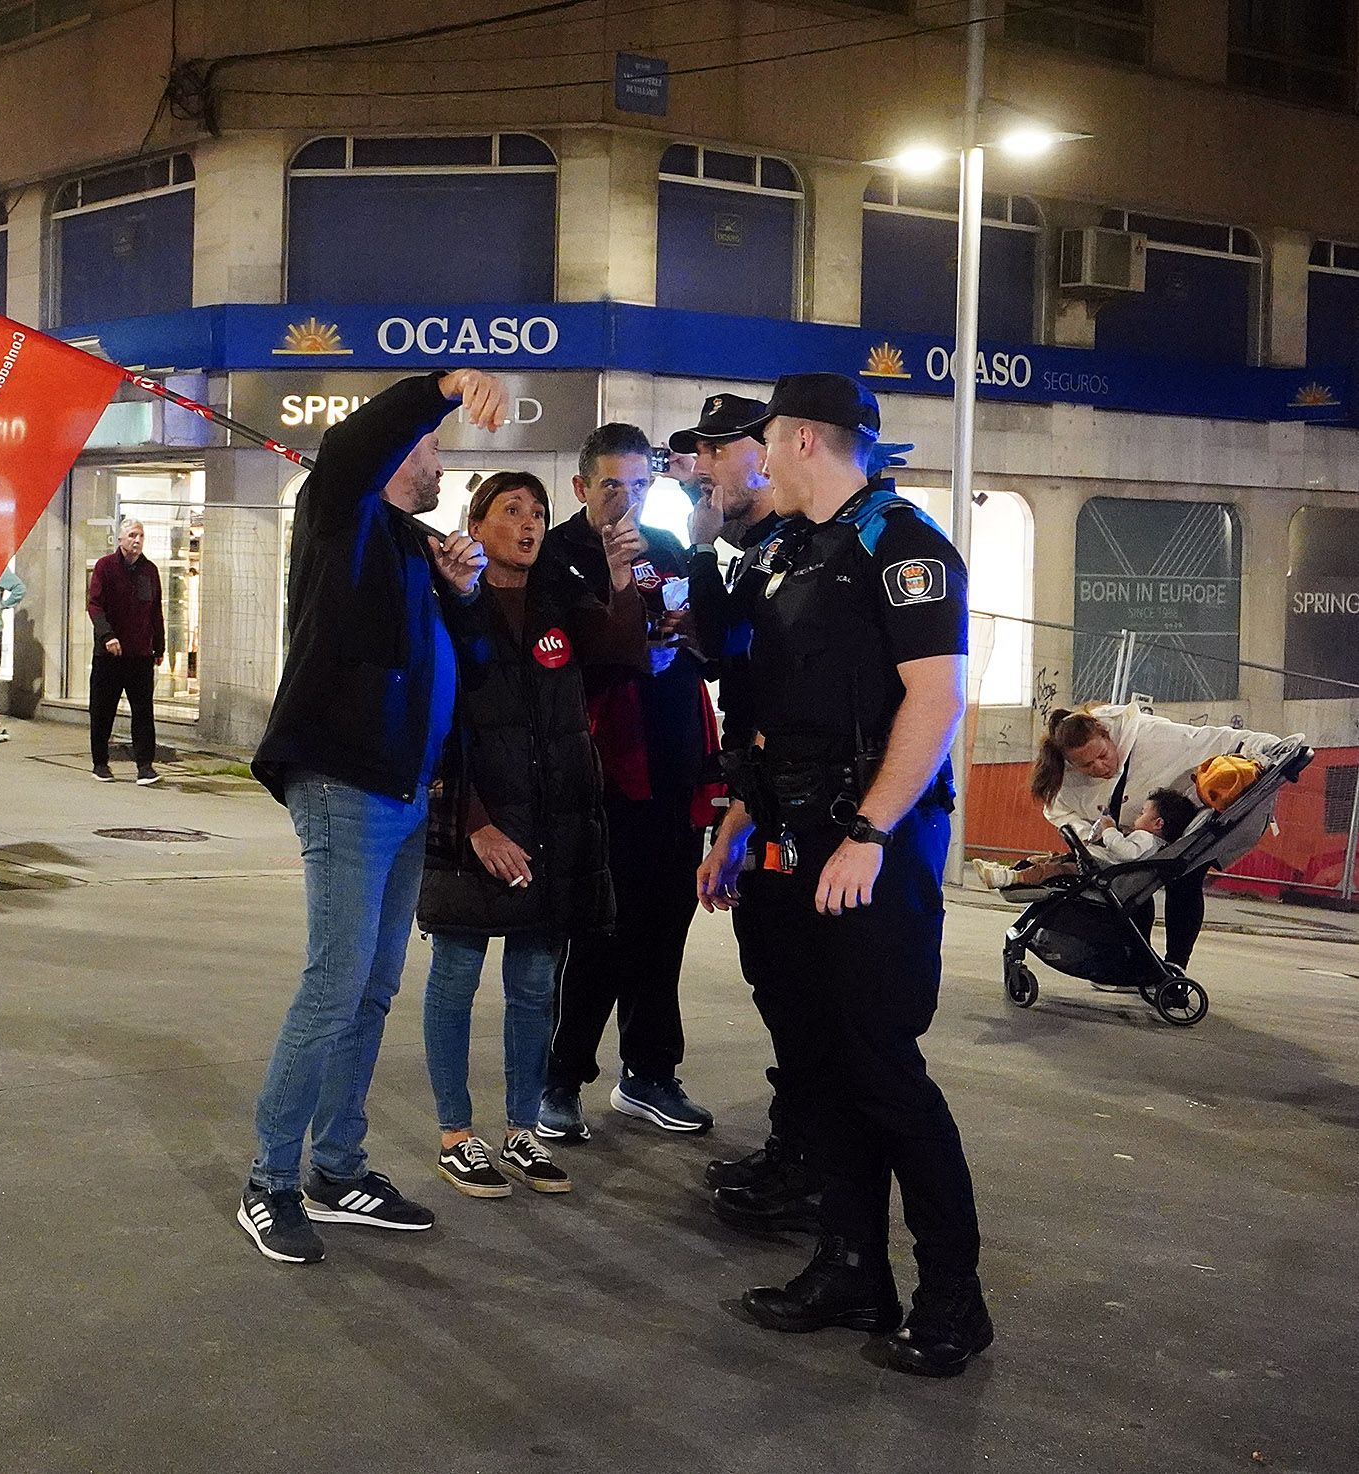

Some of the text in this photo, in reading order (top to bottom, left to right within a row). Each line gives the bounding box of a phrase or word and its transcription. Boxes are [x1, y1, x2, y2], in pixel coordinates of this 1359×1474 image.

[377, 316, 559, 355] OCASO
[1042, 371, 1109, 394] SEGUROS
[1080, 581, 1227, 604] BORN IN EUROPE
[1293, 592, 1359, 614] SPRING
